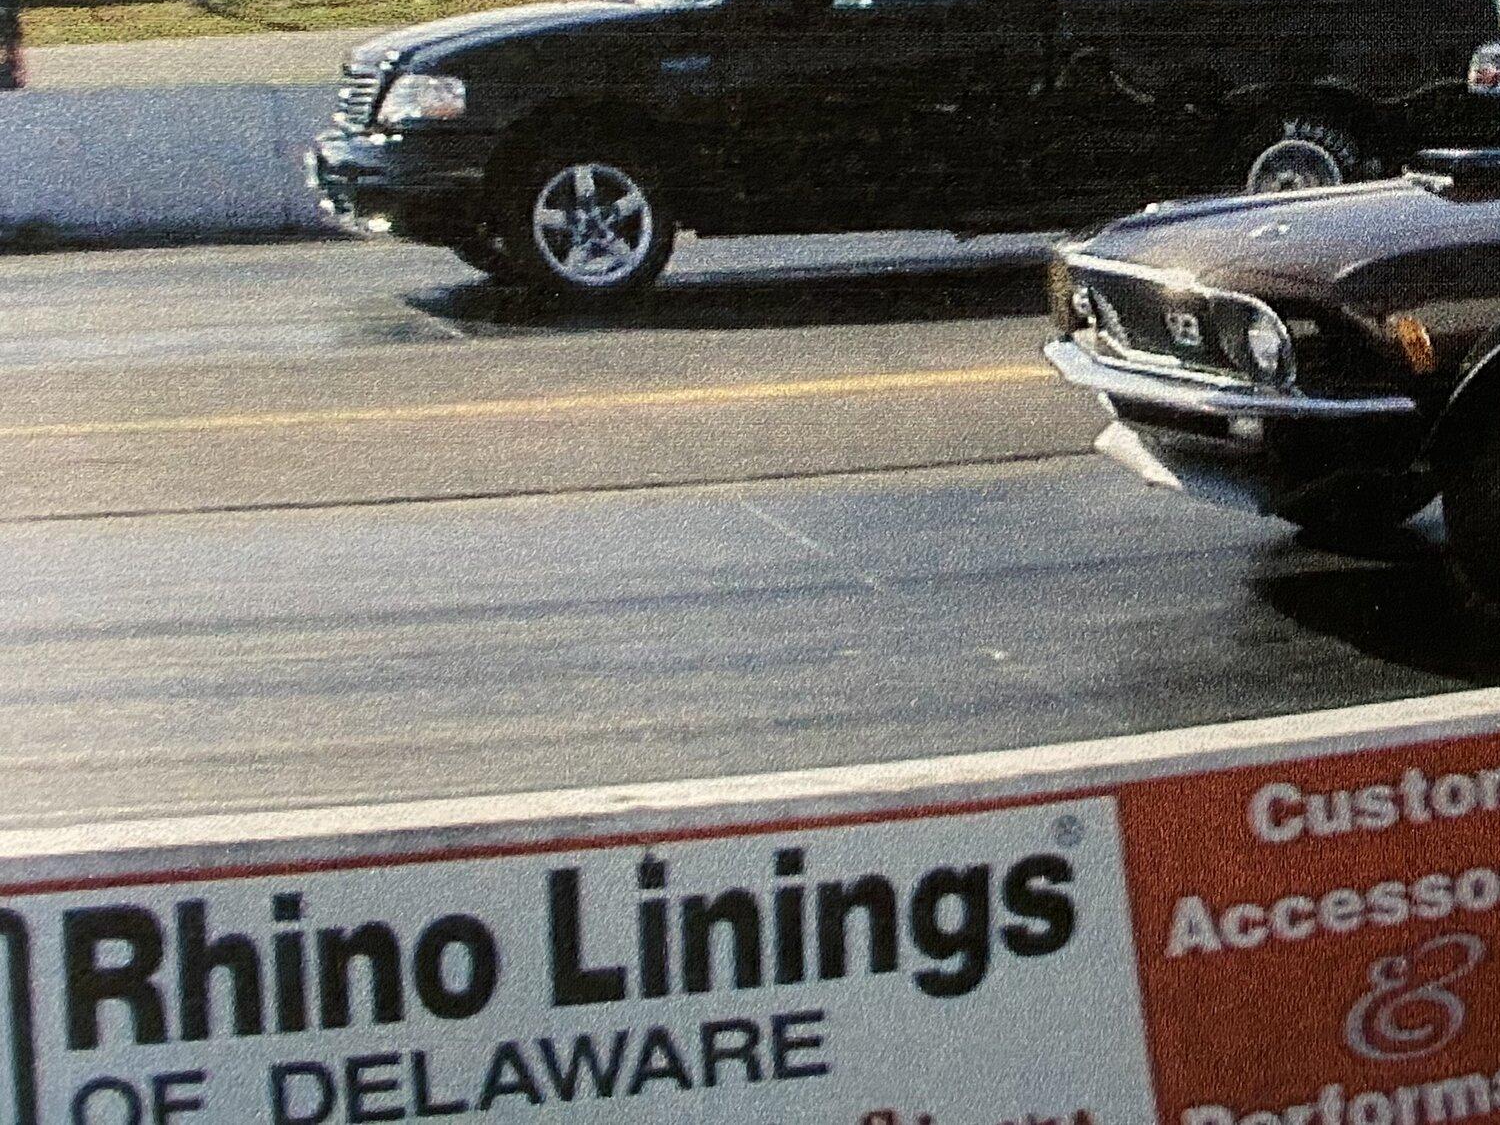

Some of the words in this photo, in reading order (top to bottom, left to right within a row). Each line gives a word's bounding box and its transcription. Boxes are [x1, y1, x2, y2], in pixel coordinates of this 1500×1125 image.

[63, 892, 500, 1050] Rhino
[547, 847, 1077, 1006] Linings
[1345, 932, 1488, 1062] &
[69, 1069, 208, 1125] OF
[269, 1009, 830, 1125] DELAWARE
